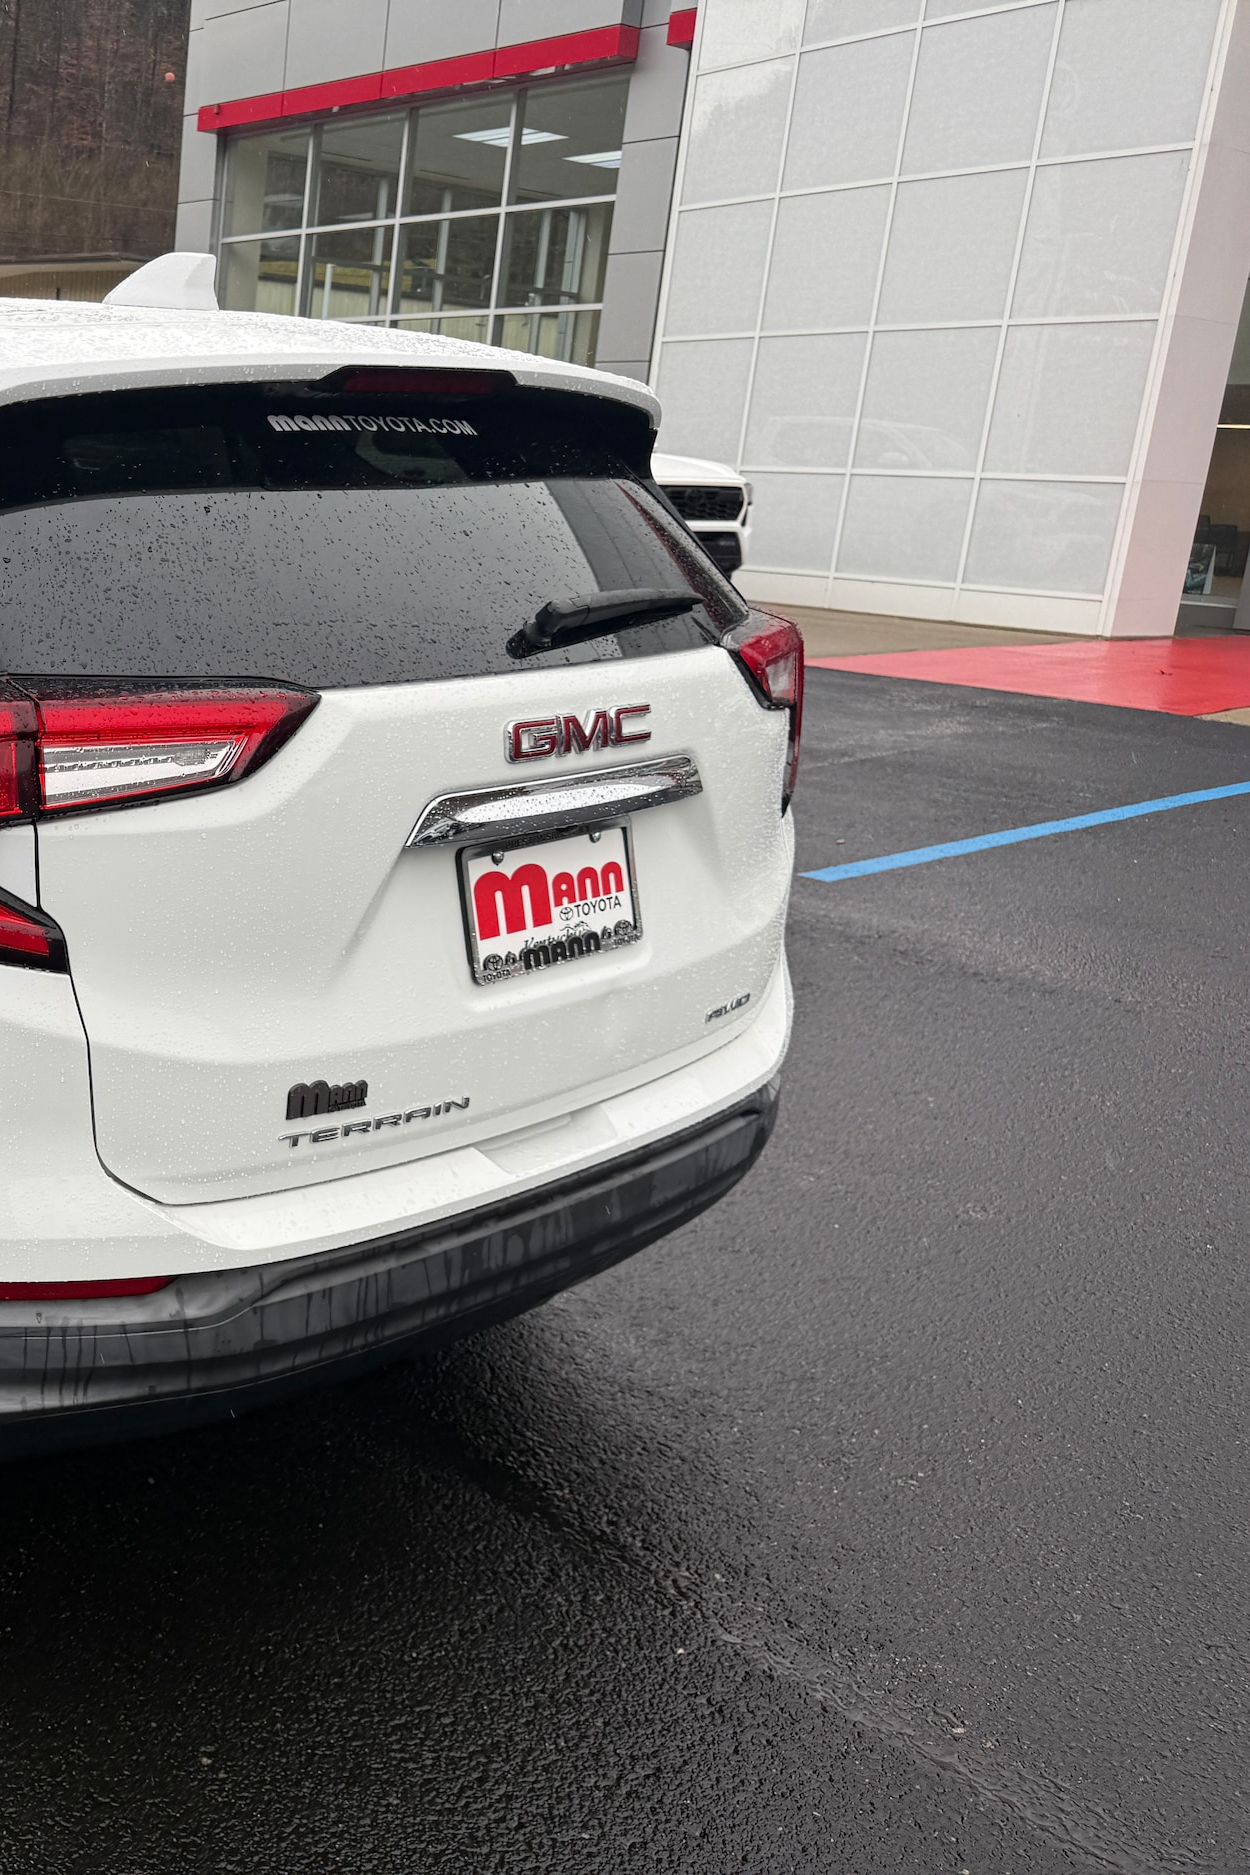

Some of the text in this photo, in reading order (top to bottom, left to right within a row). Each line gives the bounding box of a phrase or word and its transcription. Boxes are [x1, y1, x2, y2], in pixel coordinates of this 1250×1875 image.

[503, 702, 652, 764] GMC
[574, 895, 622, 918] TOYOTA
[482, 968, 512, 984] TOYOTA
[705, 993, 751, 1024] AWD
[278, 1096, 470, 1148] TERRAIN
